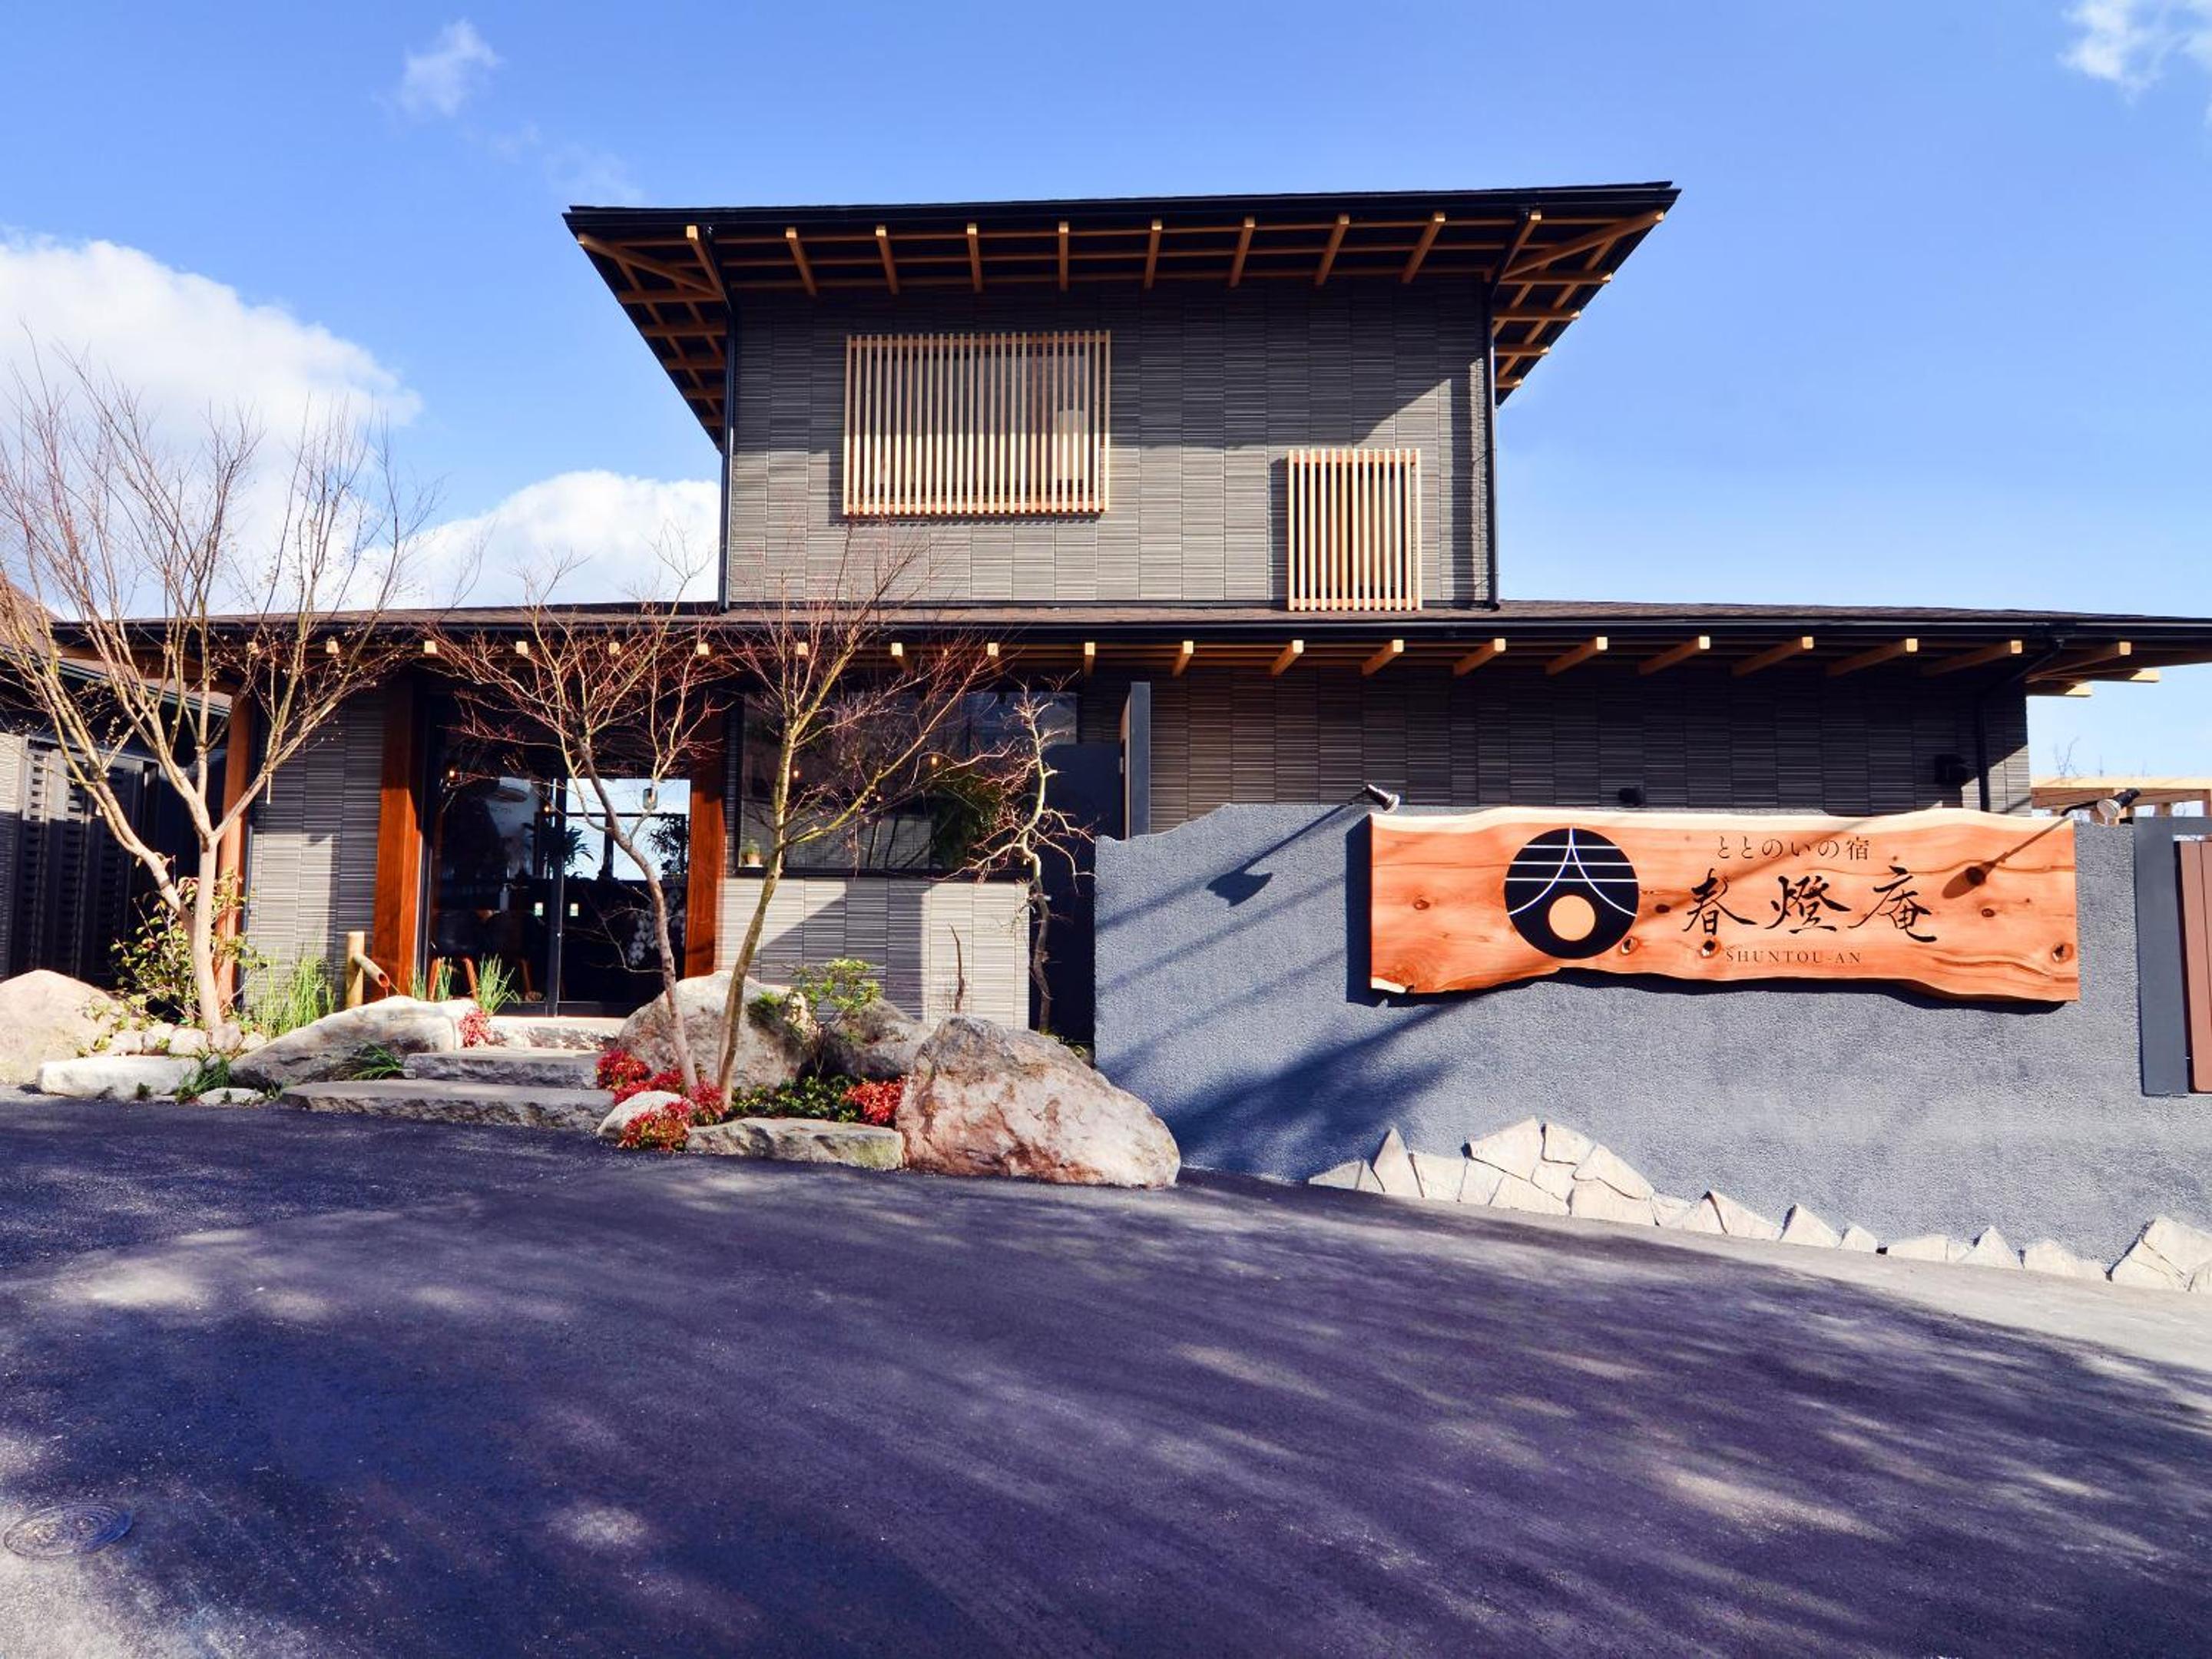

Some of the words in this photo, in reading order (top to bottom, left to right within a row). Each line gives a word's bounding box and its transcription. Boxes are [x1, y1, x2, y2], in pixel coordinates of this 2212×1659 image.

[1717, 836, 1869, 860] ととのいの宿
[1682, 866, 1937, 942] 春燈庵
